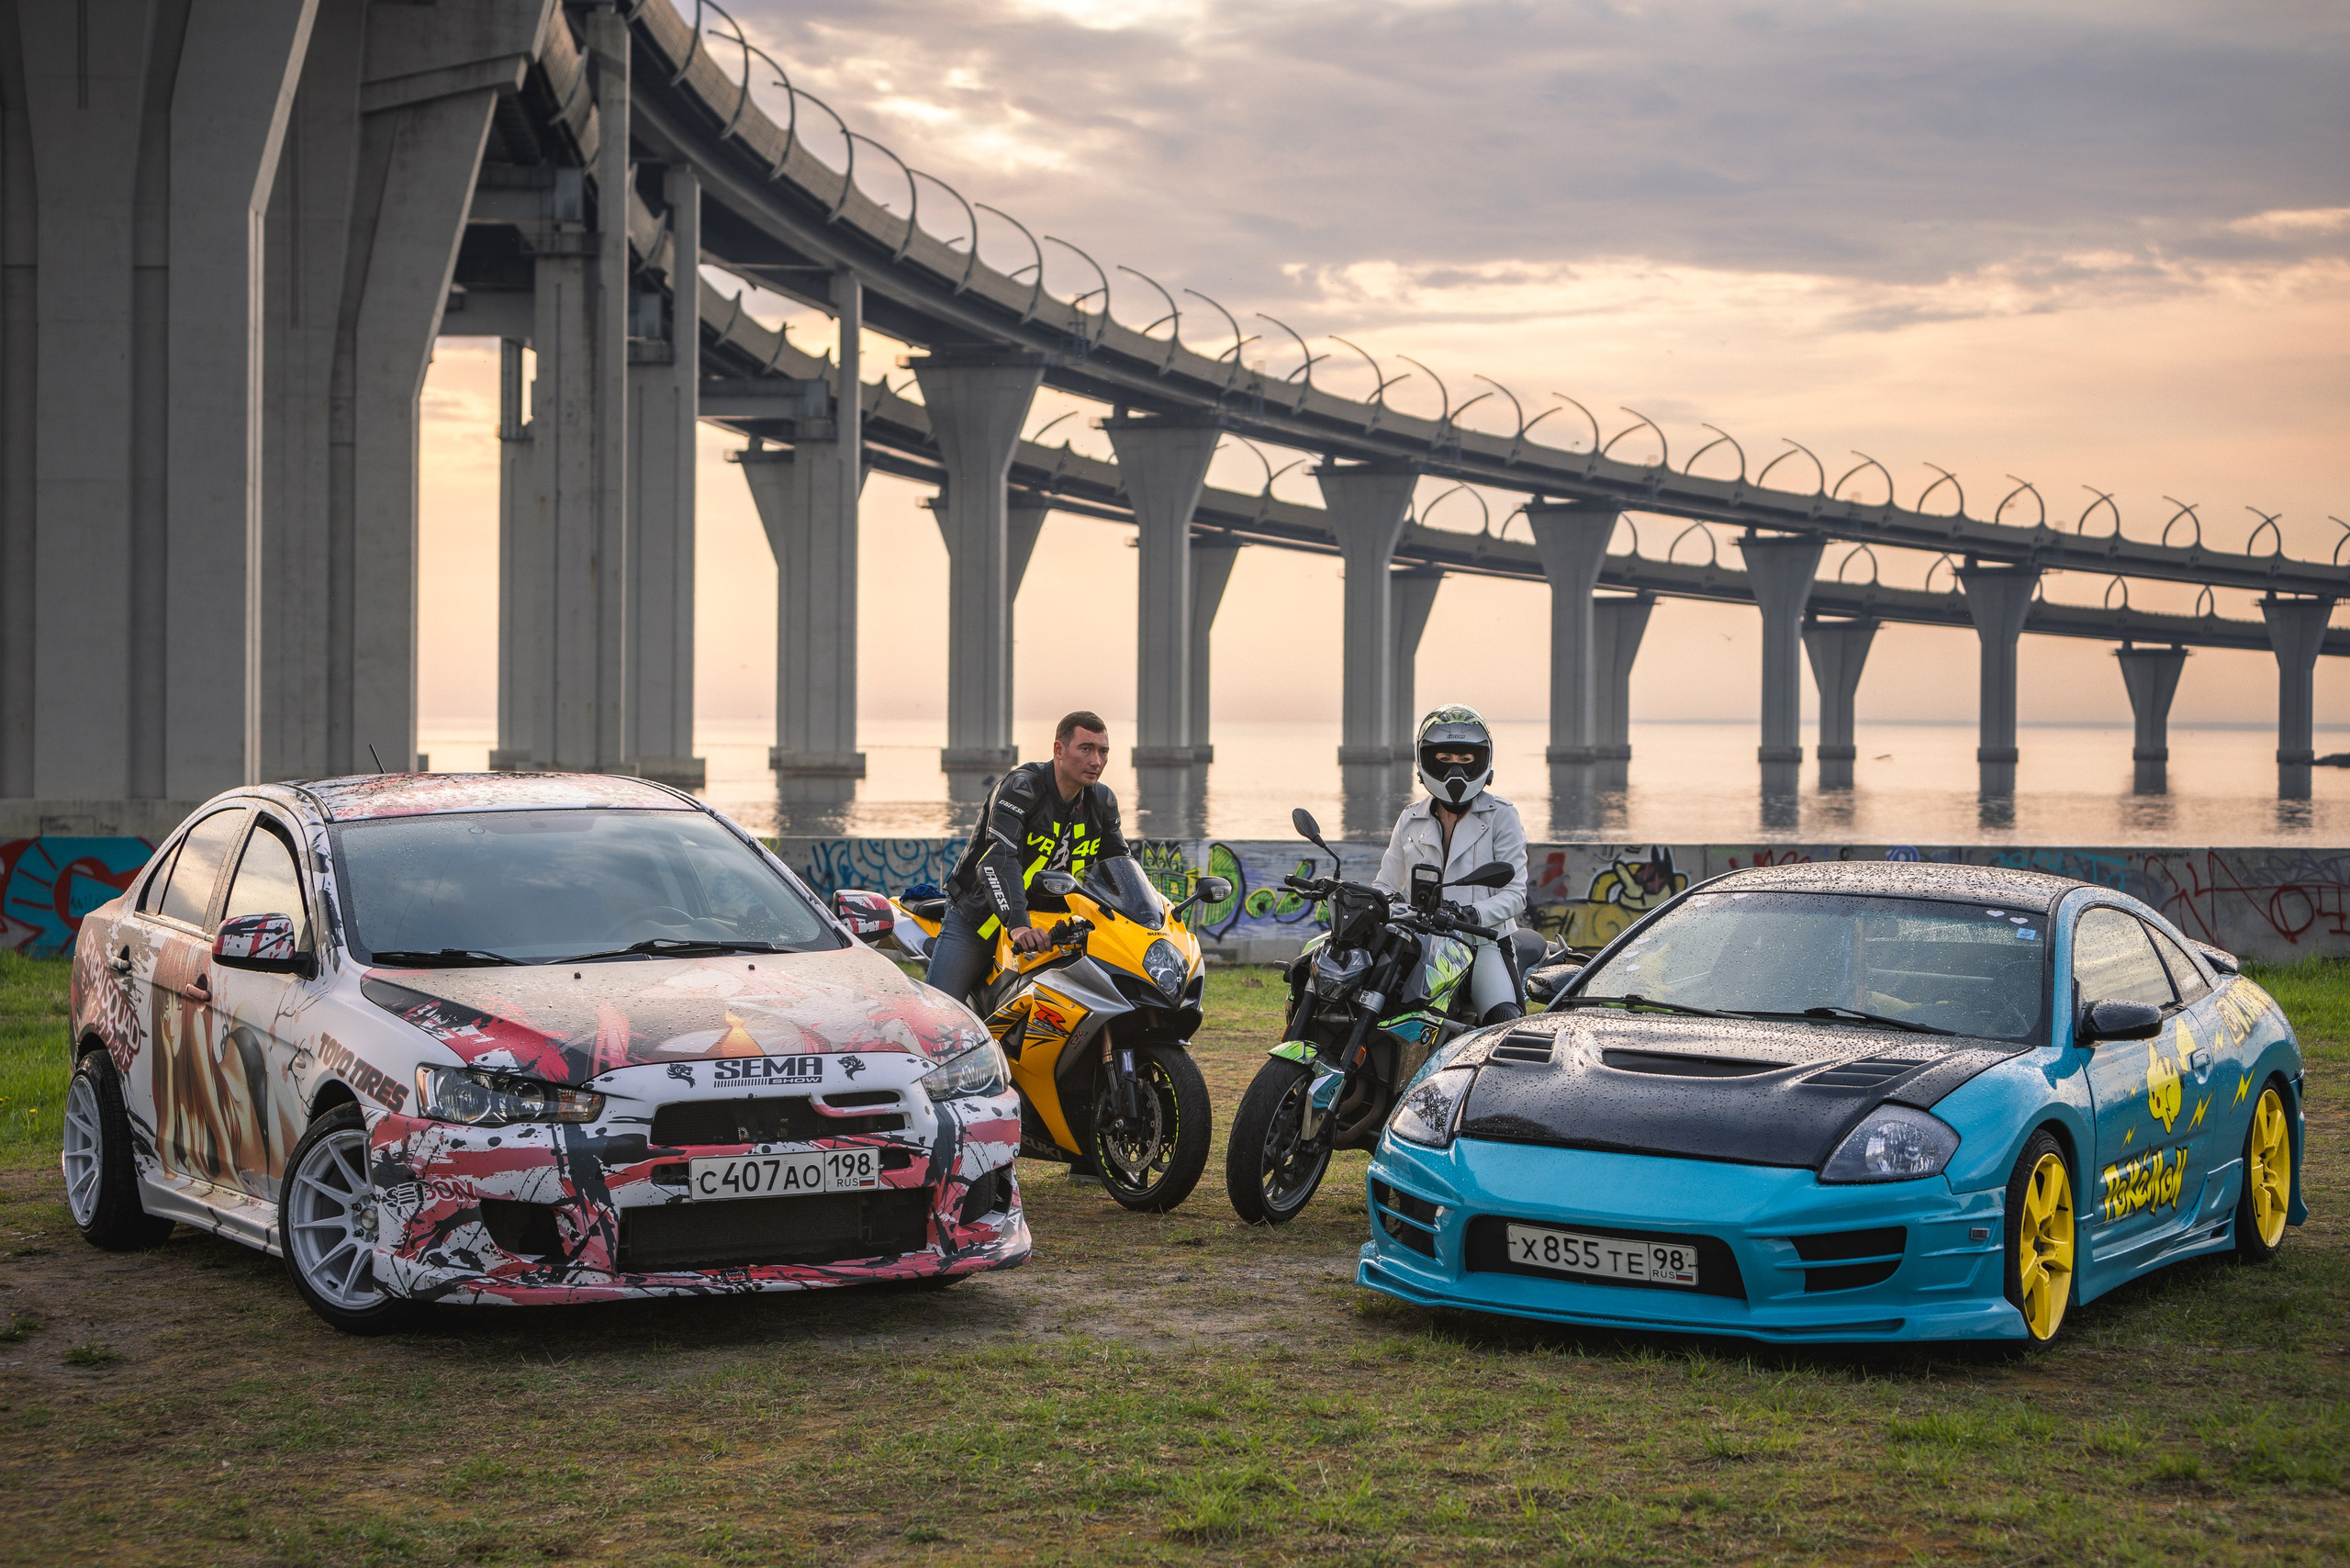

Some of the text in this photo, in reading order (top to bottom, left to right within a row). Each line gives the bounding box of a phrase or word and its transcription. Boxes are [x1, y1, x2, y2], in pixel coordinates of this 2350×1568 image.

[1027, 833, 1056, 856] VR
[102, 979, 140, 1049] SQUAD
[317, 1031, 410, 1114] TOYO TIRES
[714, 1057, 823, 1080] SEMA
[1021, 1135, 1063, 1160] ZUKI
[828, 1153, 870, 1177] 198
[836, 1178, 858, 1188] RUS
[1653, 1248, 1684, 1271] 98
[1652, 1269, 1675, 1280] RUS
